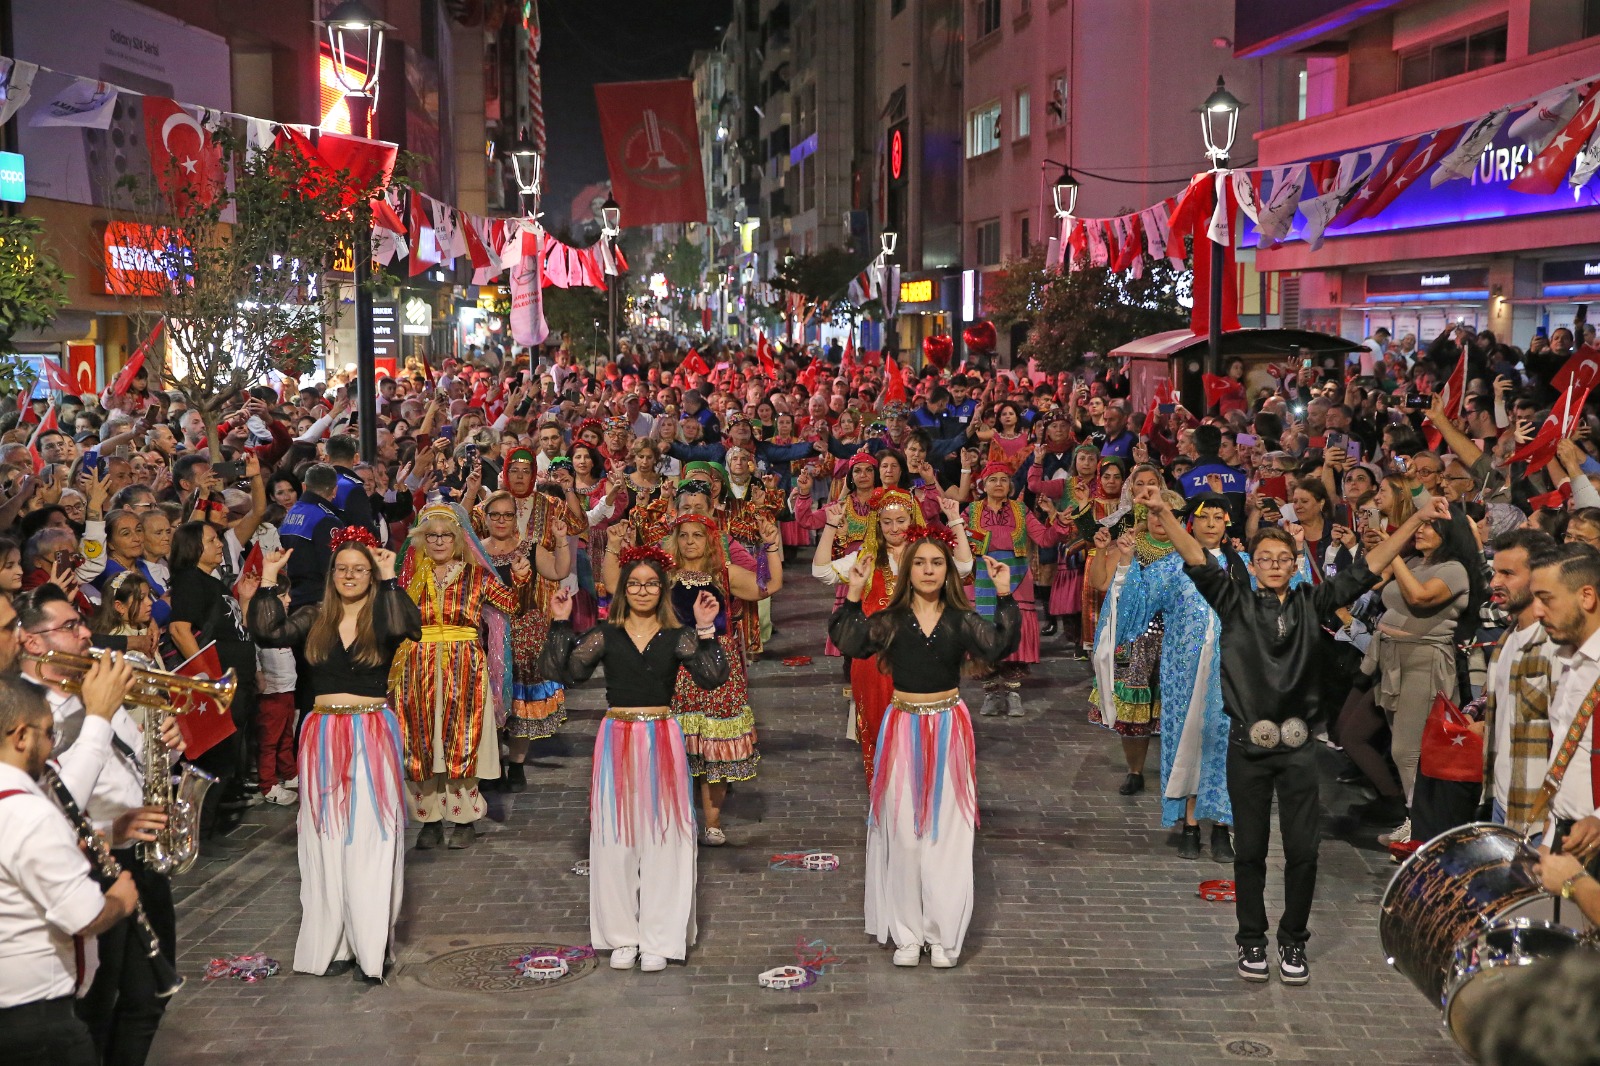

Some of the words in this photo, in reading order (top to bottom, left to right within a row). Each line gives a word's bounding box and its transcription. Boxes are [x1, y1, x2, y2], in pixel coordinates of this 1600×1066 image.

[110, 29, 132, 50] Galaxy
[144, 40, 159, 56] Serisi
[0, 169, 24, 184] oppo
